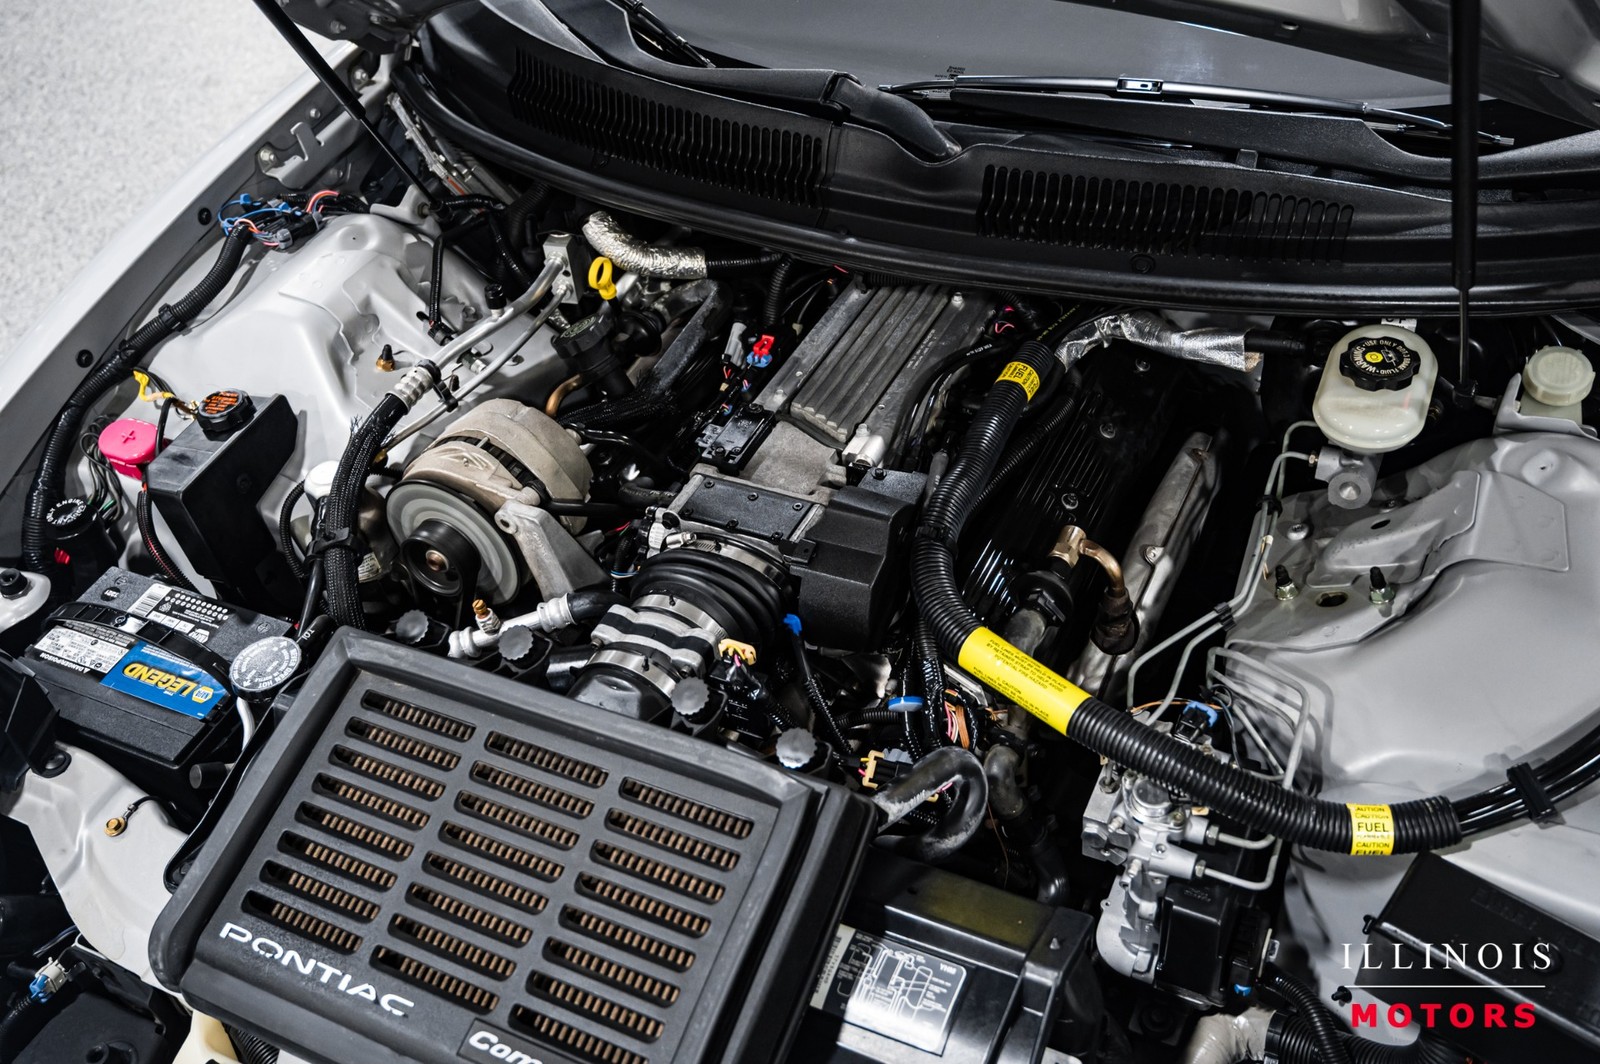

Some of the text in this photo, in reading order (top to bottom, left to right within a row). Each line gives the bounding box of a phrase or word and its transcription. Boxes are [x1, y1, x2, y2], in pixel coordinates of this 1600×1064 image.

[1354, 345, 1376, 373] WARNING
[1014, 364, 1028, 378] FUEL
[56, 498, 84, 508] ENGINE
[123, 663, 198, 698] LEGEND
[258, 680, 273, 689] HOT
[1002, 680, 1022, 694] CAUTION
[1357, 822, 1390, 832] FUEL
[218, 922, 415, 1017] PONTIAC
